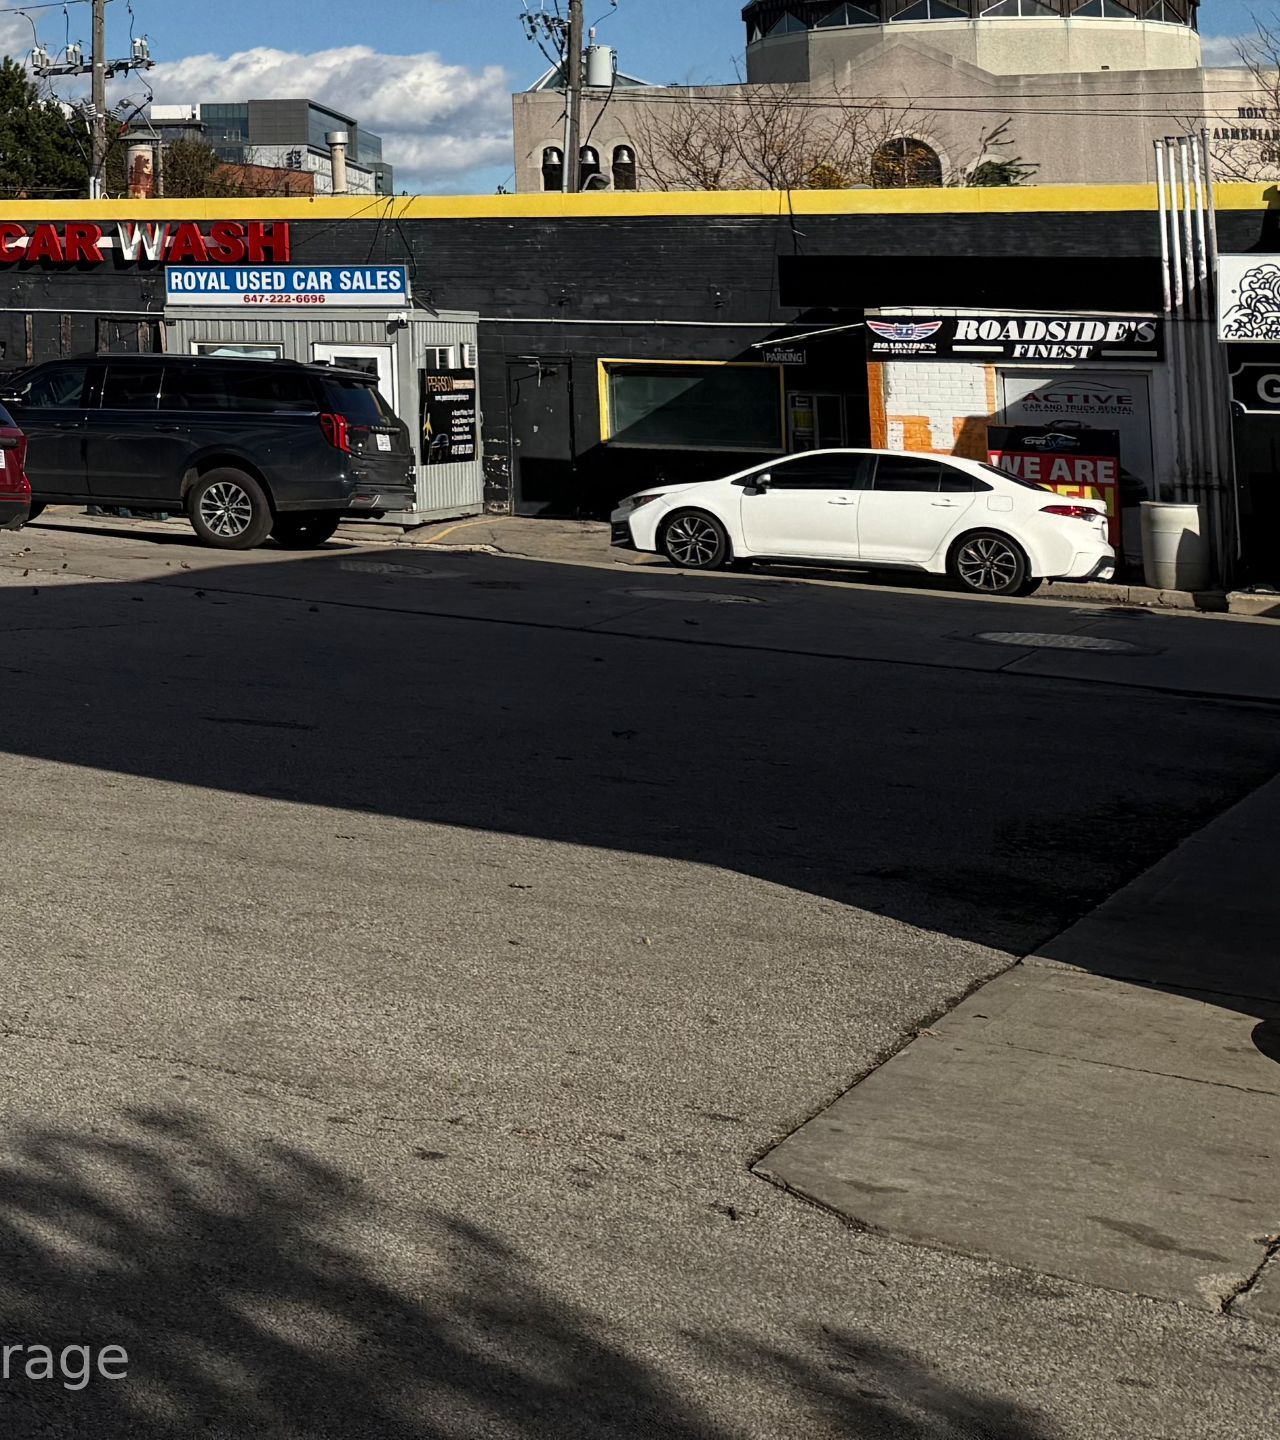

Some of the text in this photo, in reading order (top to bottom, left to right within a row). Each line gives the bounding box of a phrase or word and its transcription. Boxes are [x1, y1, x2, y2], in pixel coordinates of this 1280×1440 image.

[116, 221, 290, 262] WASH
[171, 270, 402, 291] ROYAL USED CAR SALES
[243, 294, 326, 304] 647-222-6696
[952, 319, 1157, 343] ROADSIDE'S
[1012, 344, 1093, 359] FINEST
[1020, 392, 1134, 406] ACTIVE
[1041, 403, 1062, 411] AND
[1064, 404, 1098, 412] TRUCK
[1099, 405, 1133, 413] RENTAL
[990, 455, 1115, 484] WE ARE
